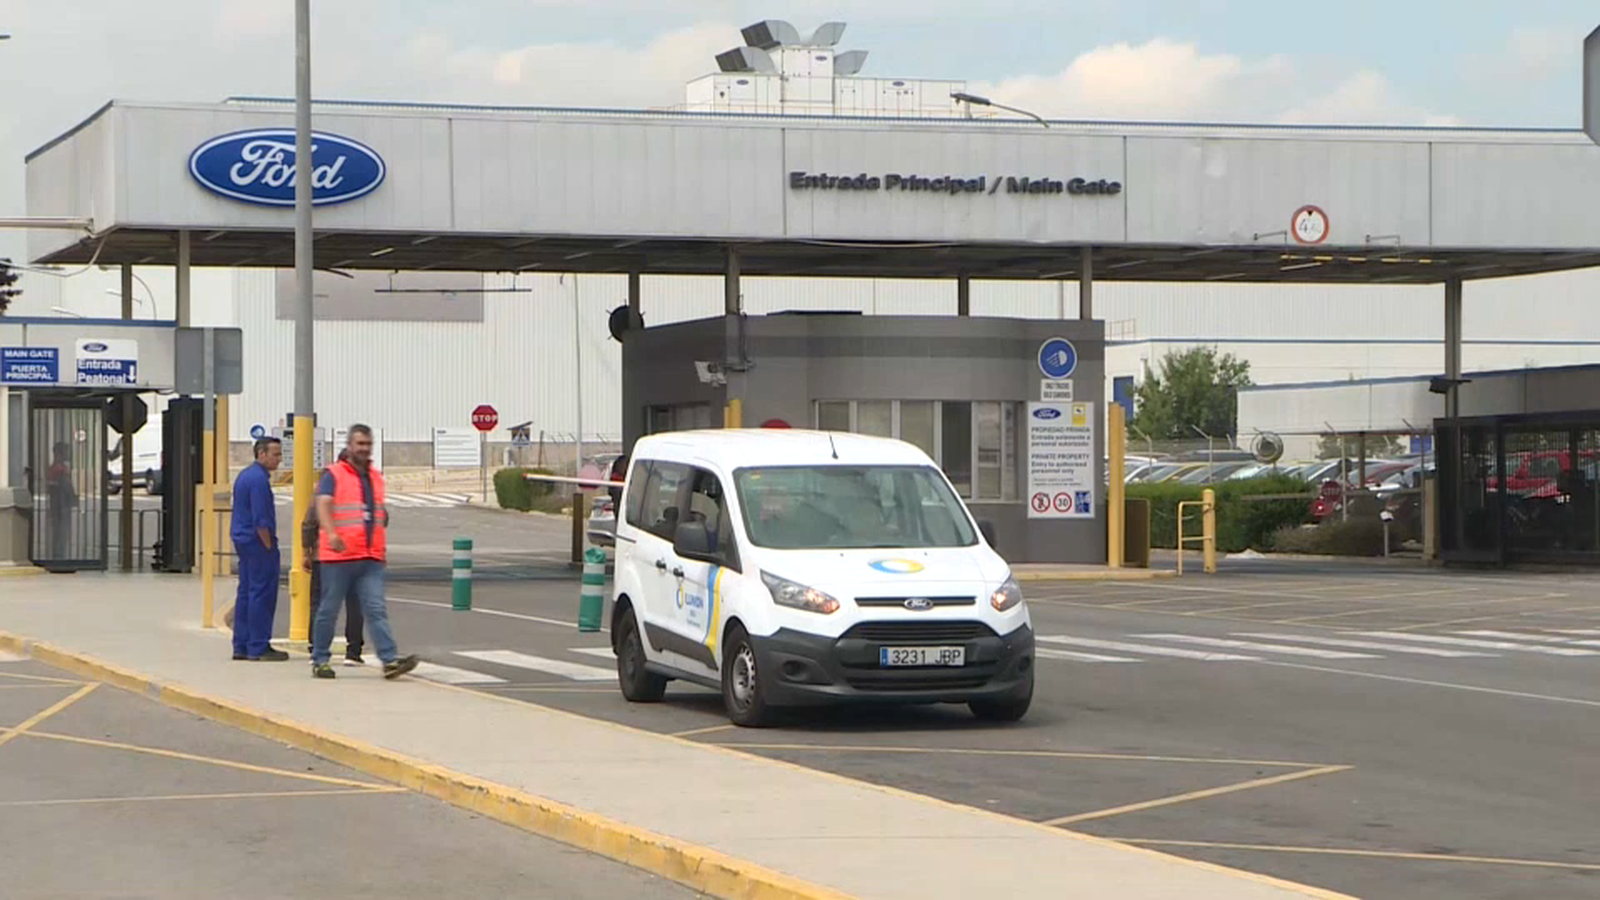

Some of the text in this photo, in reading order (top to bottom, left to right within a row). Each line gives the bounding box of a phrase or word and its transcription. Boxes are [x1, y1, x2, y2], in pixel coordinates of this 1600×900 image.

[230, 140, 347, 189] Fod
[789, 171, 881, 191] Entrada
[885, 173, 986, 196] Principal
[1006, 176, 1063, 194] Main
[1066, 177, 1122, 195] Gate
[5, 350, 54, 358] MAIN GATE
[78, 359, 122, 370] Entrada
[6, 372, 54, 380] PRINCIPAL
[78, 372, 127, 383] Peatonal
[472, 414, 498, 423] STOP
[1057, 497, 1069, 507] 30
[892, 649, 961, 664] 3231 JBP
